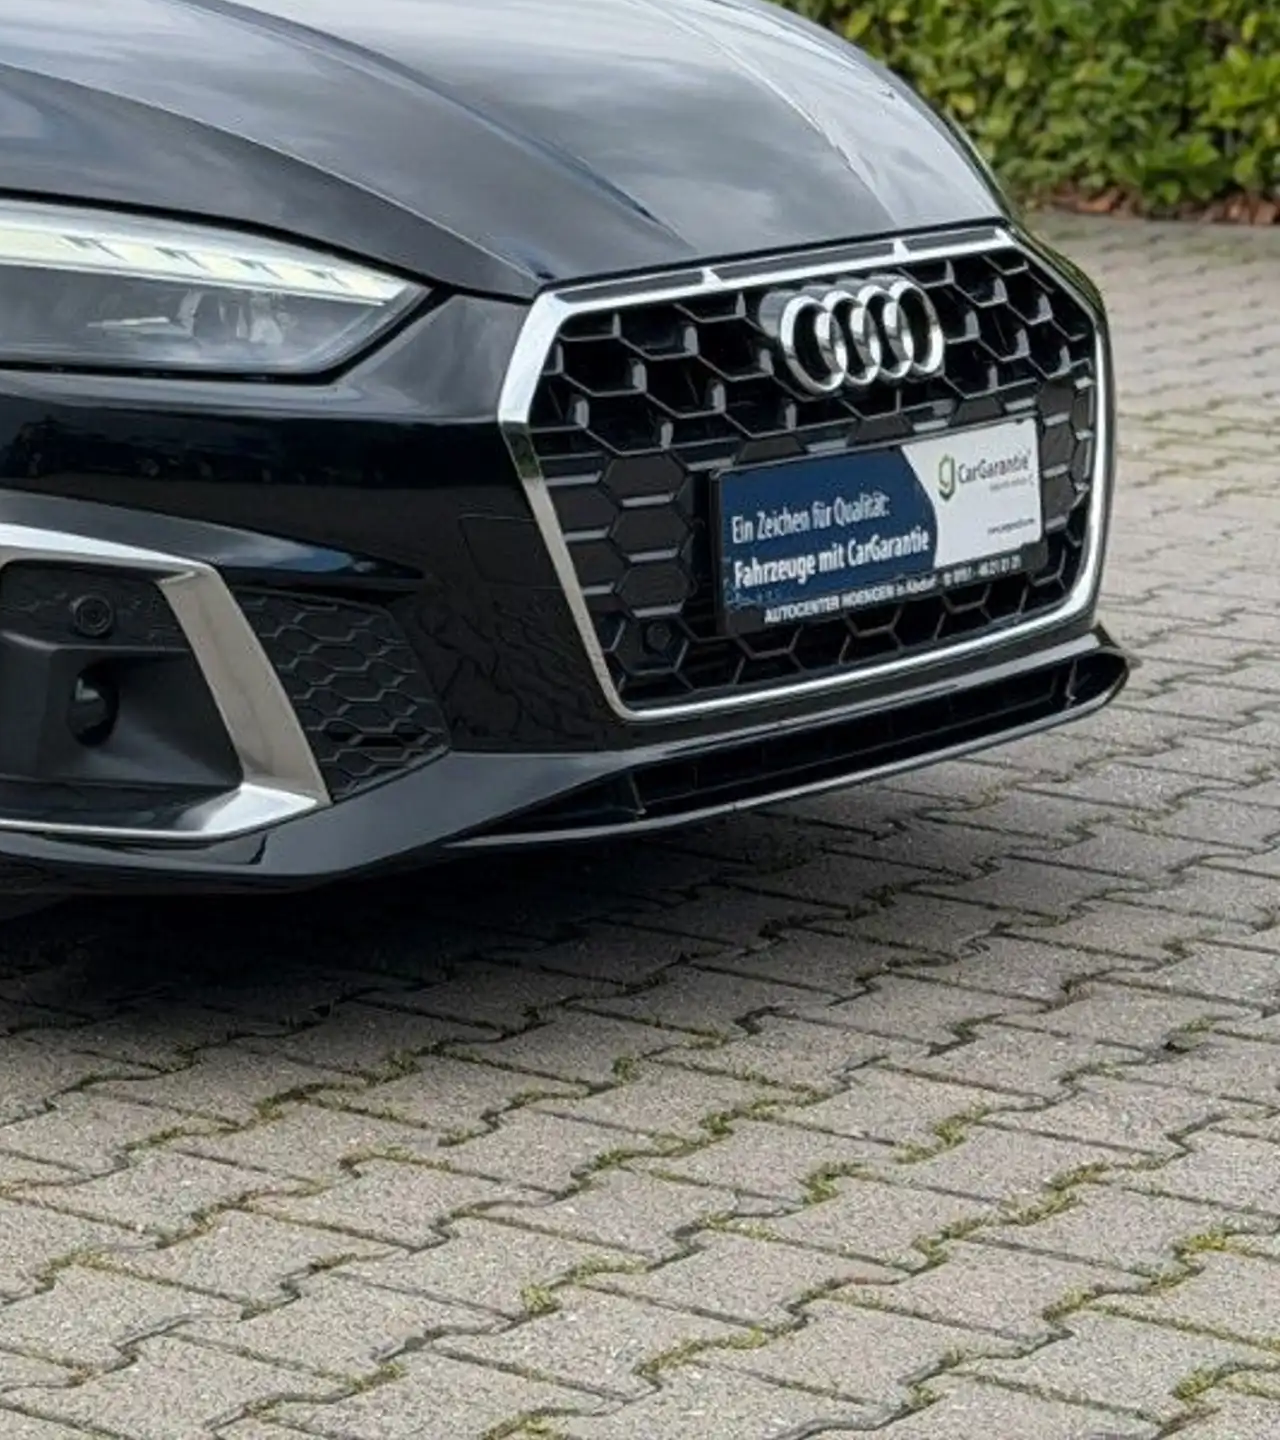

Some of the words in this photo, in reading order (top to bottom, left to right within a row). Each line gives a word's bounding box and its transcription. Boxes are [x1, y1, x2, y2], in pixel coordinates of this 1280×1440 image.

[731, 515, 754, 544] Ein
[756, 506, 811, 539] Zeichen
[812, 501, 833, 528] für
[833, 491, 891, 527] Qualität:
[734, 556, 816, 590] Fahrzeuge
[818, 542, 846, 572] mit
[847, 524, 930, 567] CarGarantie
[764, 594, 841, 624] AUTOCENTER
